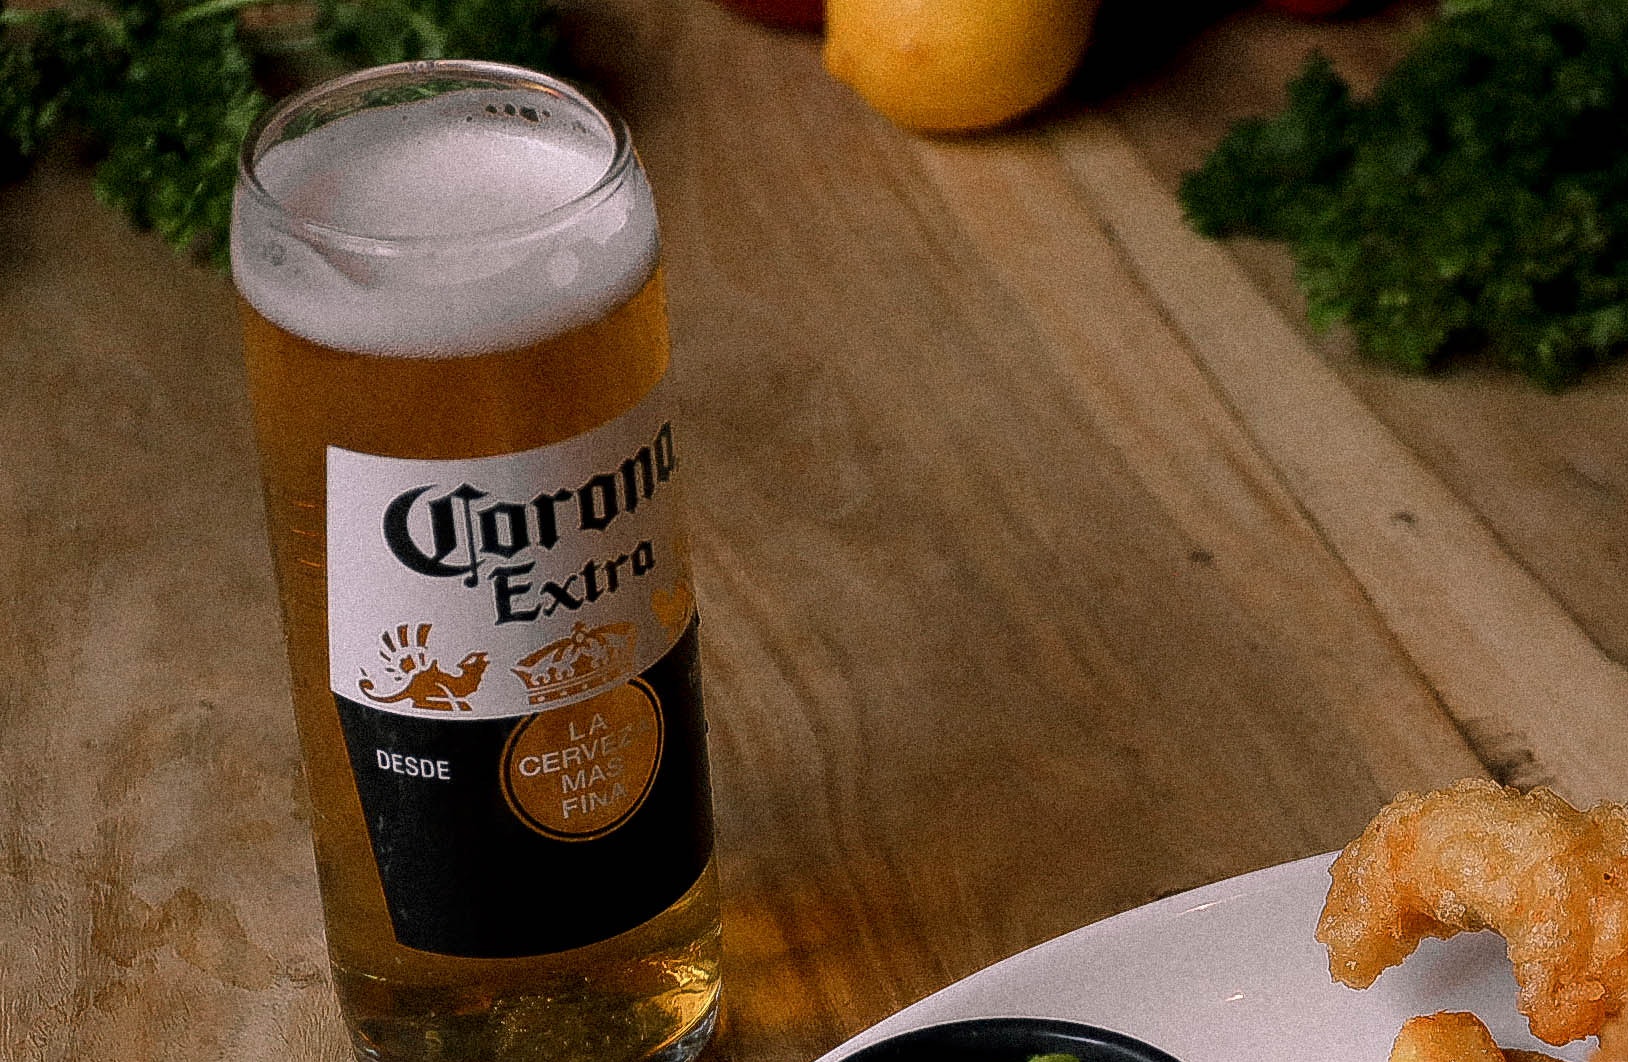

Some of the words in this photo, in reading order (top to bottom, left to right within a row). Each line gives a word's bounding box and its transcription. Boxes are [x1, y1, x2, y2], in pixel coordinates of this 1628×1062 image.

[383, 421, 677, 588] Corona
[487, 541, 655, 626] Extra
[568, 713, 607, 741] LA
[376, 749, 451, 780] DESDE
[561, 757, 624, 793] MAS
[562, 782, 627, 819] FINA
